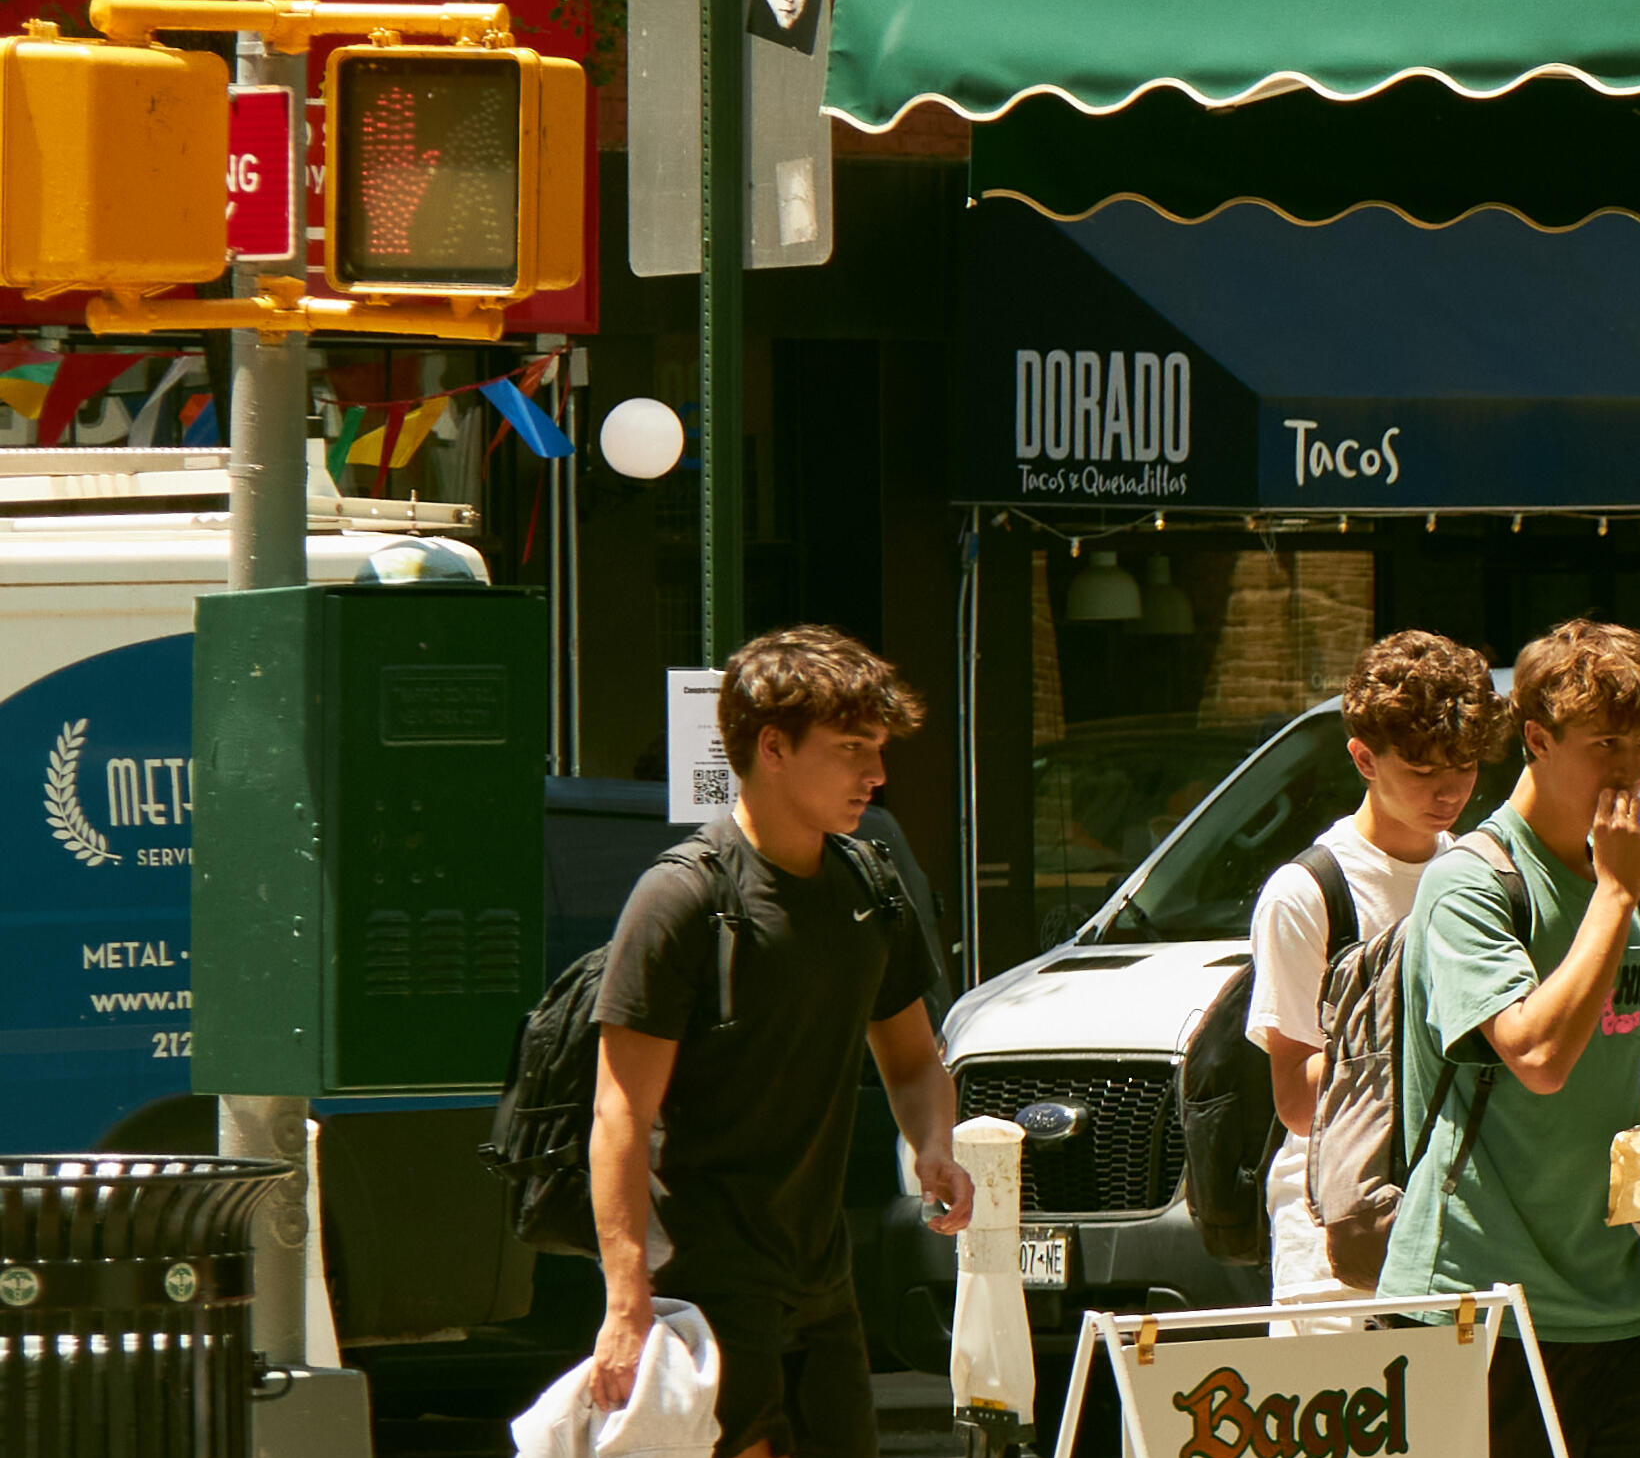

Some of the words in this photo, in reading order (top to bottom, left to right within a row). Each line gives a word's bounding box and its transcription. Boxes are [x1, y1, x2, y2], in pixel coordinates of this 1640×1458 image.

[1016, 349, 1191, 463] DORADO
[1284, 418, 1400, 487] Tacos
[1017, 464, 1067, 494] Tacos
[1083, 463, 1188, 496] Quesadillas
[83, 940, 175, 969] METAL
